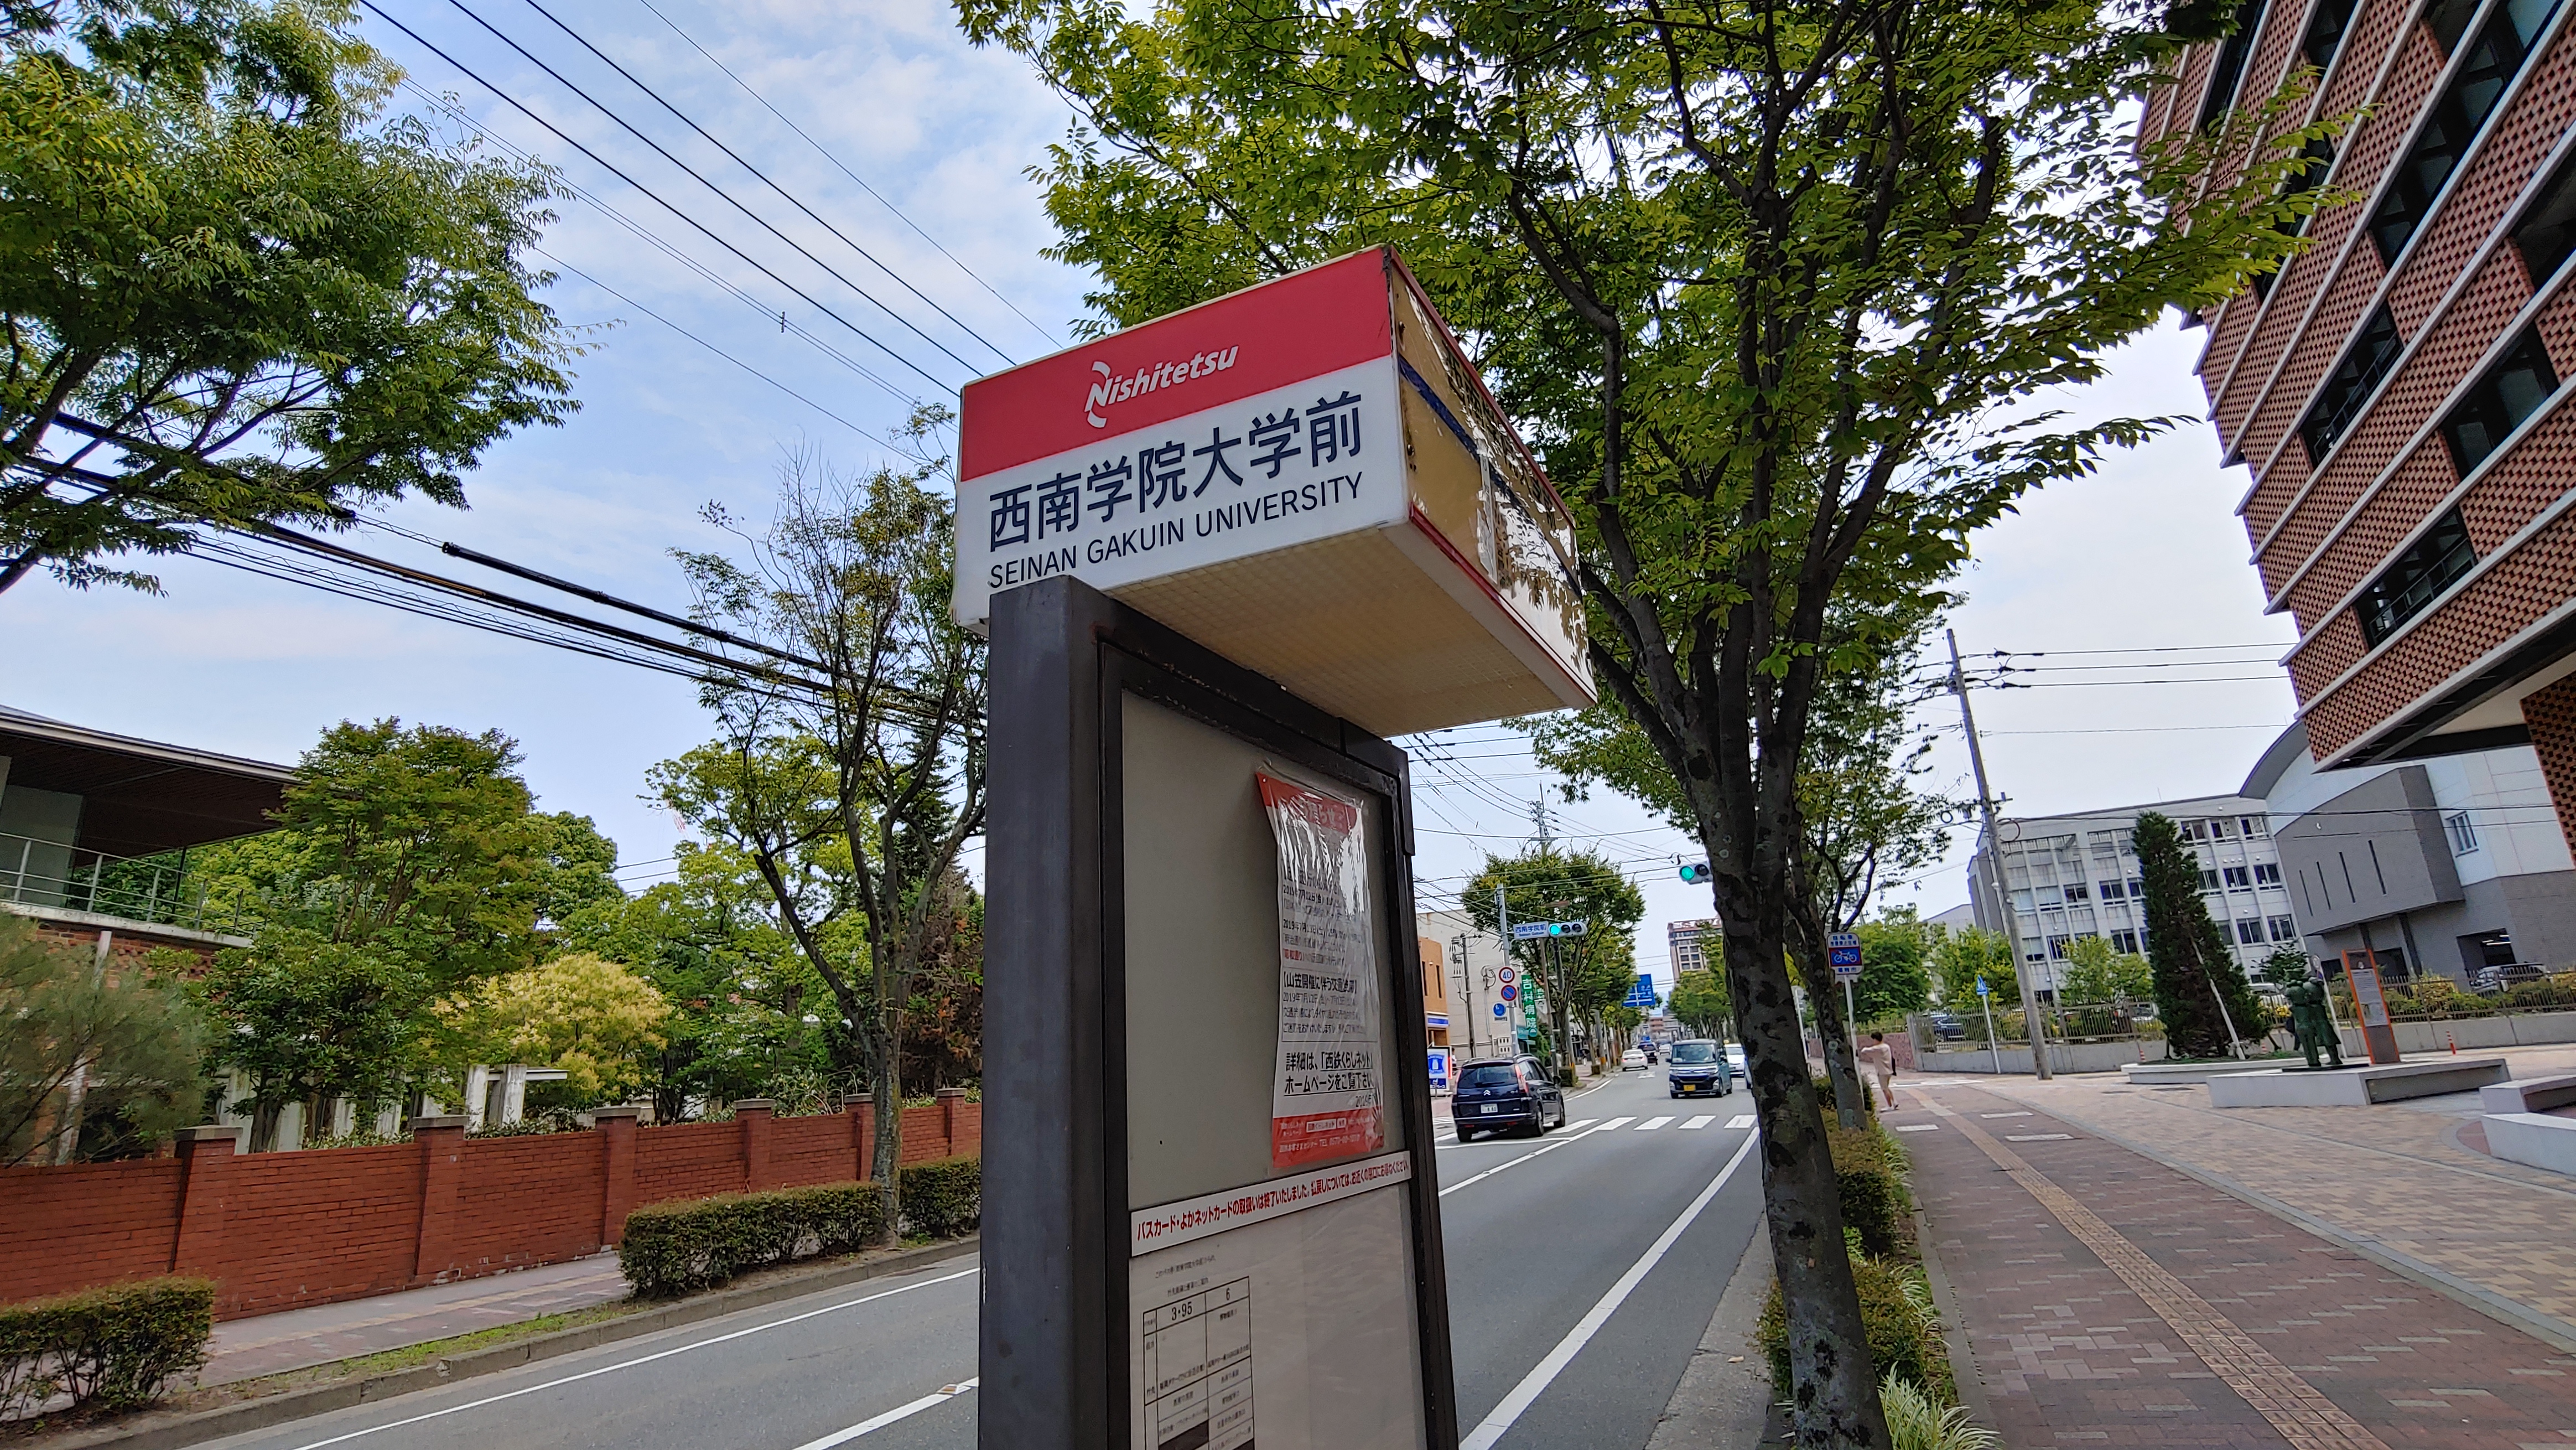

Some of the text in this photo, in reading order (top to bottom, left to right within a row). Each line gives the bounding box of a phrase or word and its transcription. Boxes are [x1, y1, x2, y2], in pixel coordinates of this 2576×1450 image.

[1084, 344, 1239, 428] Nishitetsu
[990, 391, 1362, 552] 西南学院大学前
[990, 472, 1363, 588] SEINAN GAKUIN UNIVERSITY
[1502, 971, 1512, 979] 40
[1522, 978, 1537, 1028] 吉村病院
[1225, 1287, 1231, 1301] 6
